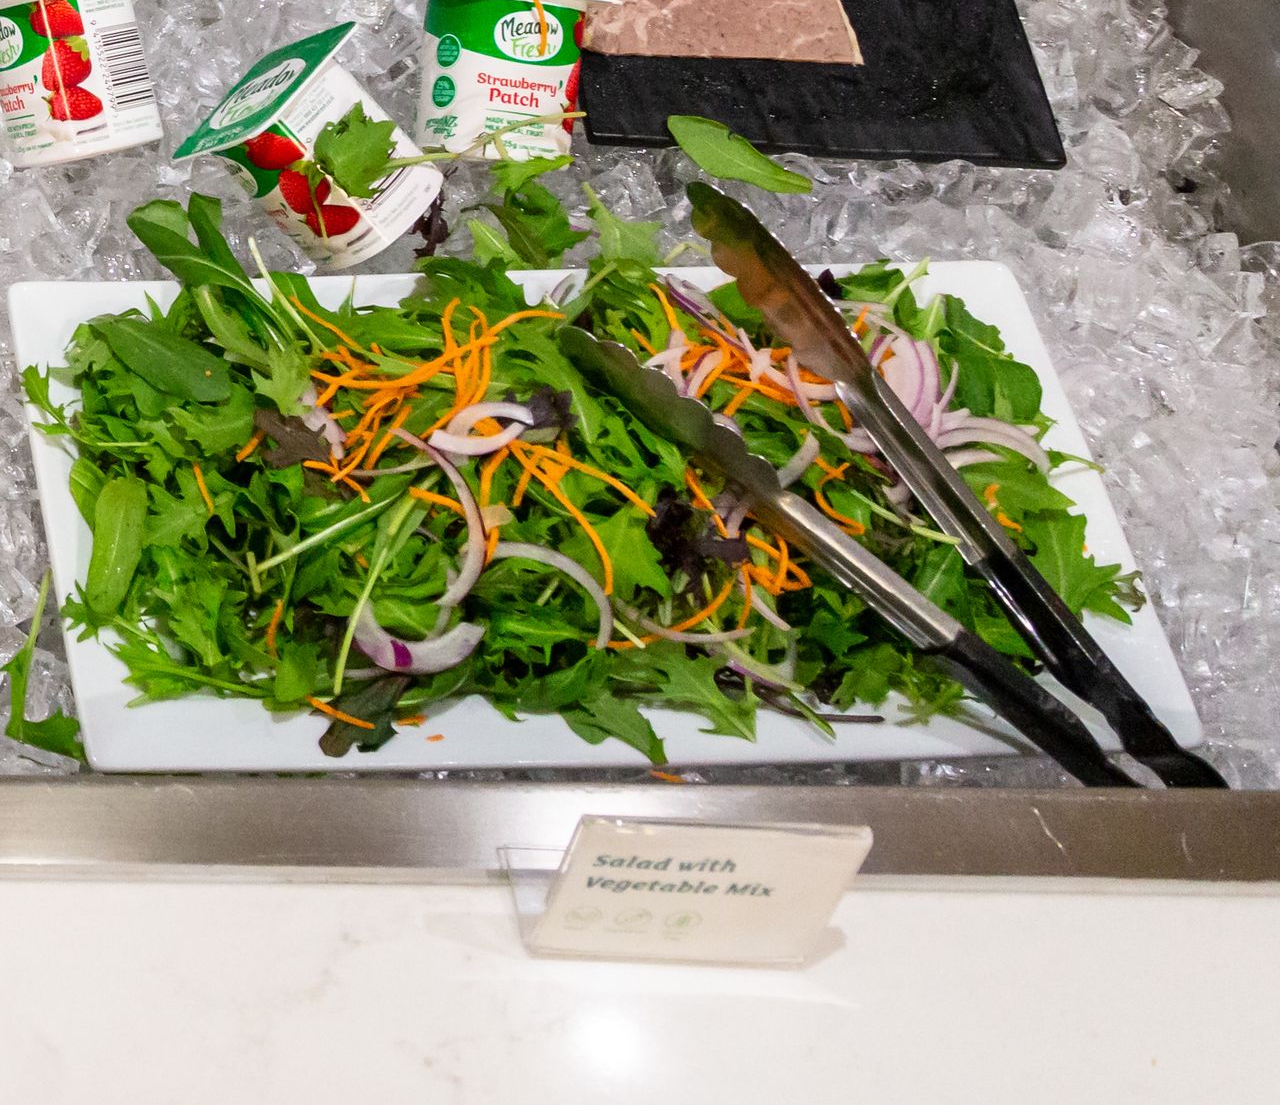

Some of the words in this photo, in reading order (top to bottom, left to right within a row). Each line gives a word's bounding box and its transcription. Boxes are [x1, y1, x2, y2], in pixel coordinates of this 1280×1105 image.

[477, 72, 558, 97] Strawberry
[489, 88, 539, 108] Patch
[593, 854, 671, 872] Salad
[679, 857, 737, 873] with
[586, 876, 719, 896] Vegetable
[725, 882, 775, 898] Mix
